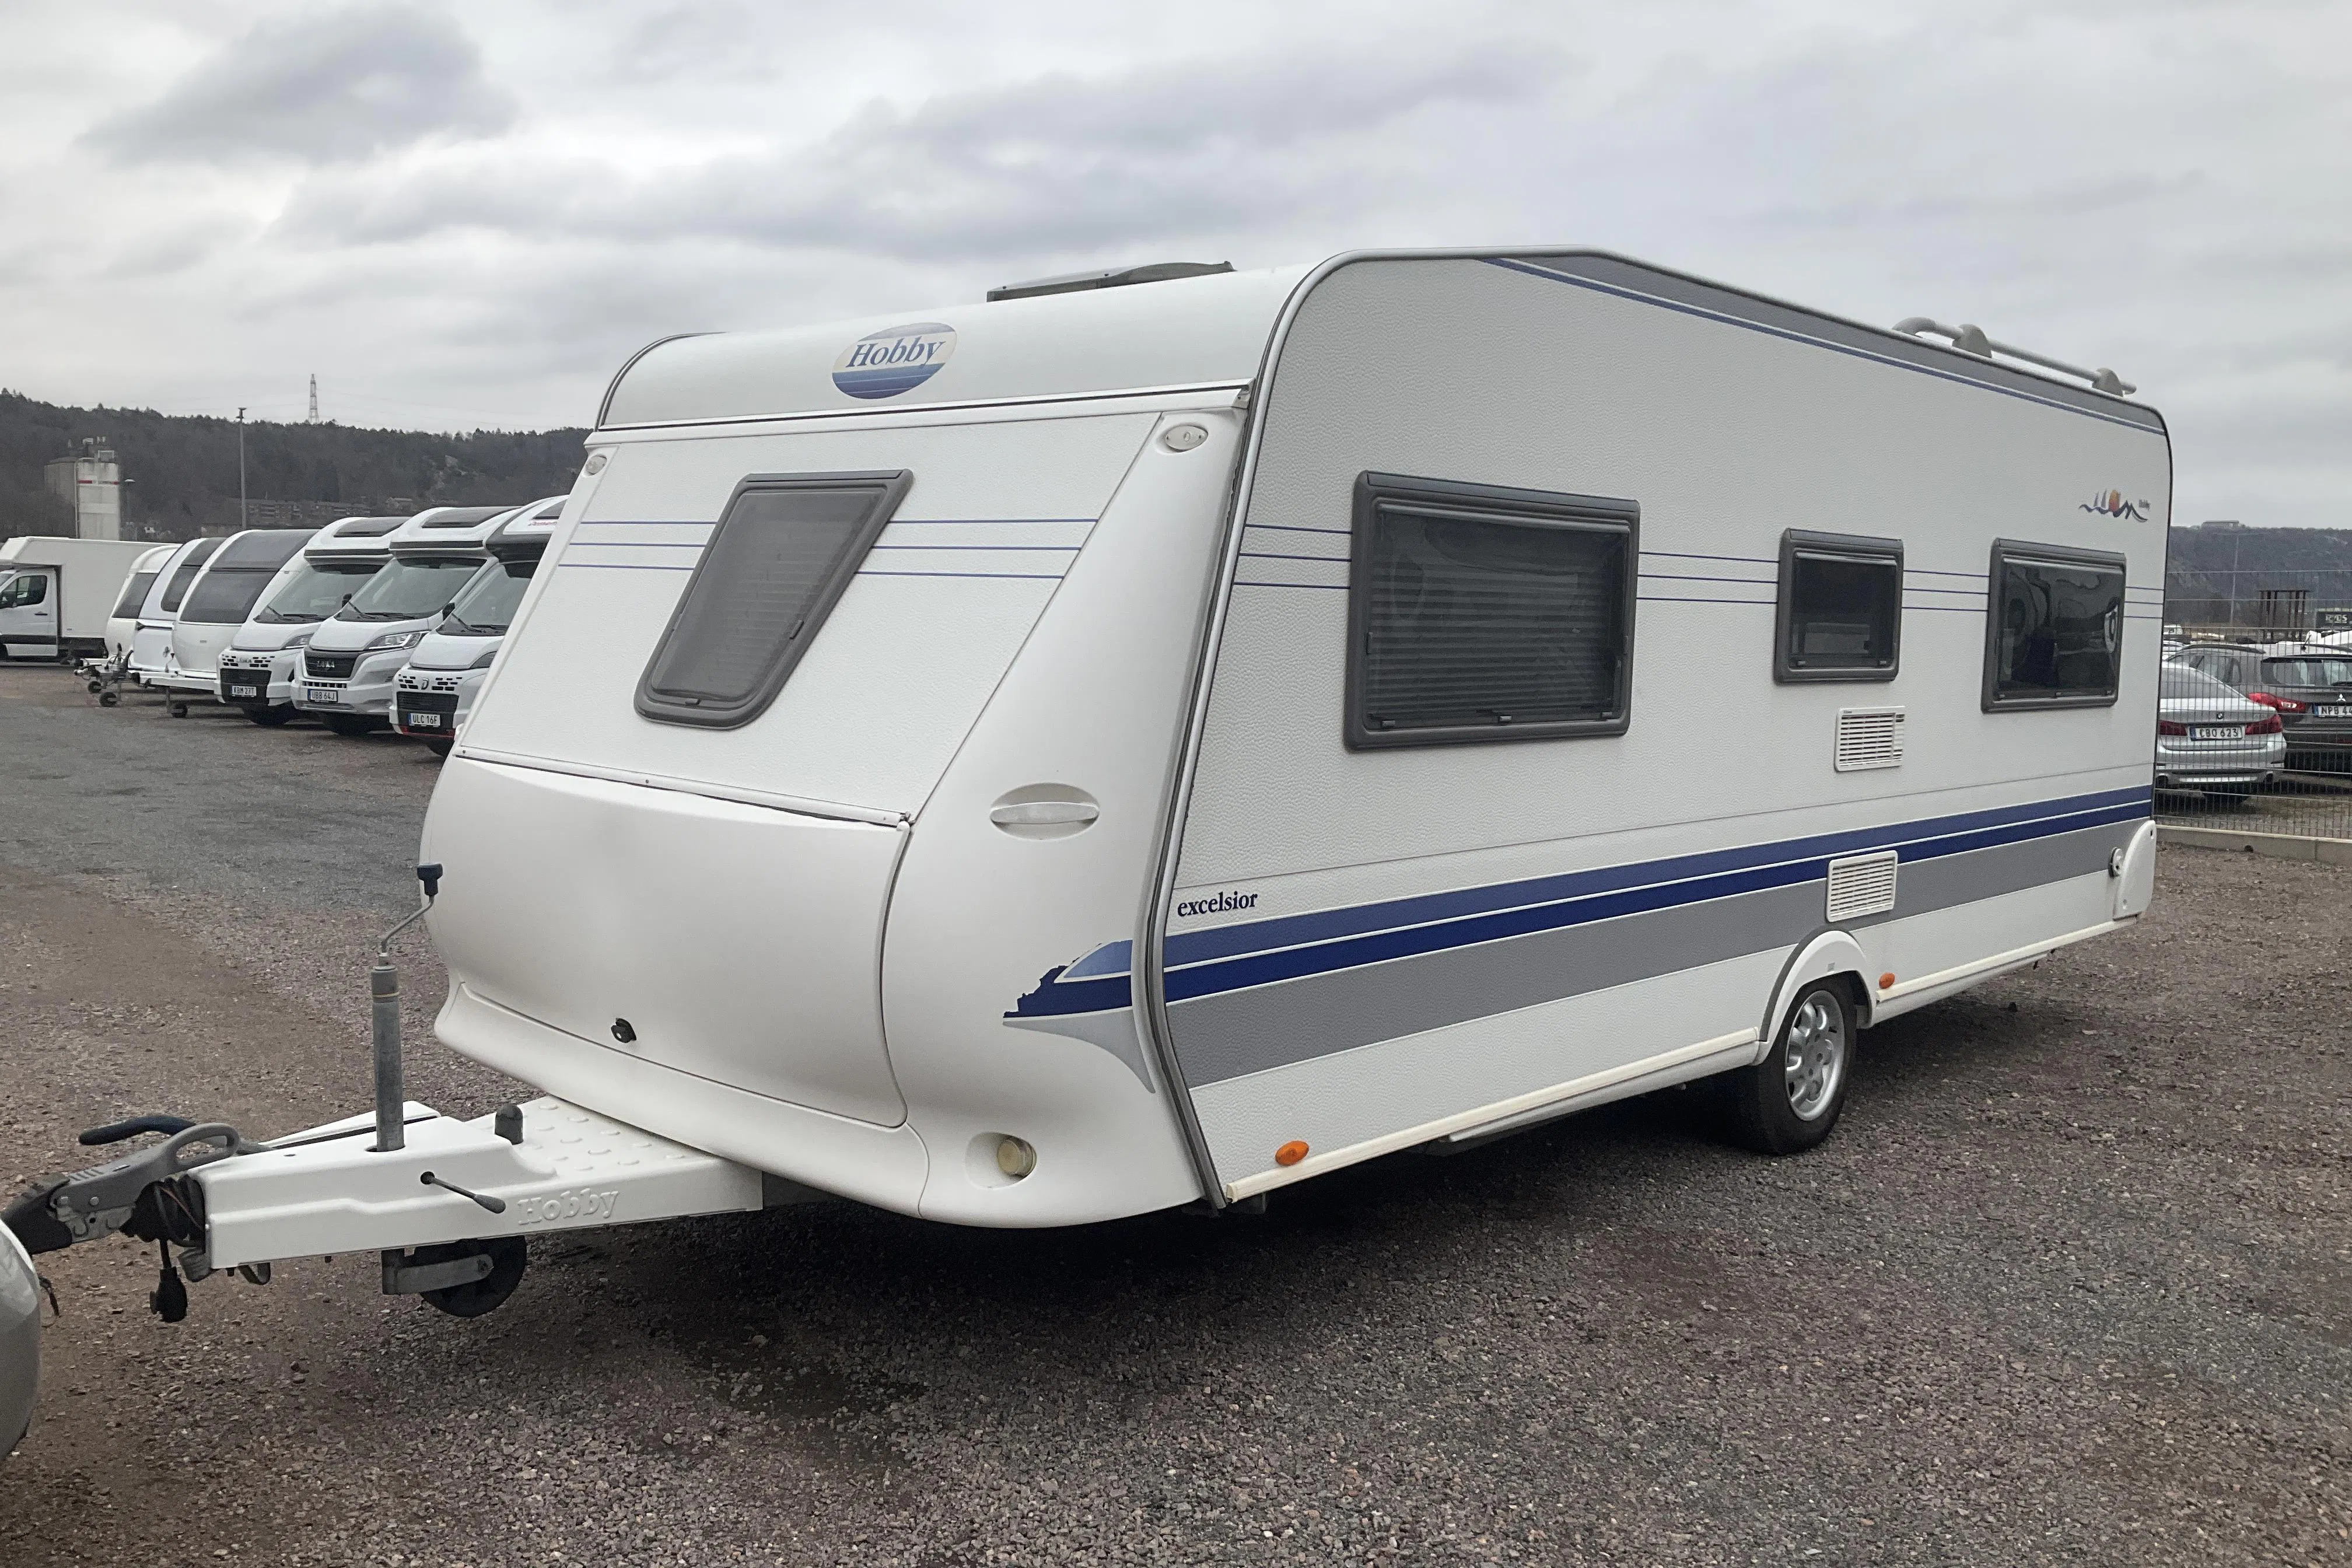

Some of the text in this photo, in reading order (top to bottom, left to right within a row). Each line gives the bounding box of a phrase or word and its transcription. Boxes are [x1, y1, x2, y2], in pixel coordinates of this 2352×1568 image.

[845, 335, 947, 368] Hobby
[244, 687, 254, 695] 27T
[2321, 706, 2339, 715] NPB
[412, 714, 438, 724] ULC 16F
[2220, 727, 2239, 737] 623
[1177, 891, 1258, 917] excelsior
[517, 1187, 620, 1226] Hobby
